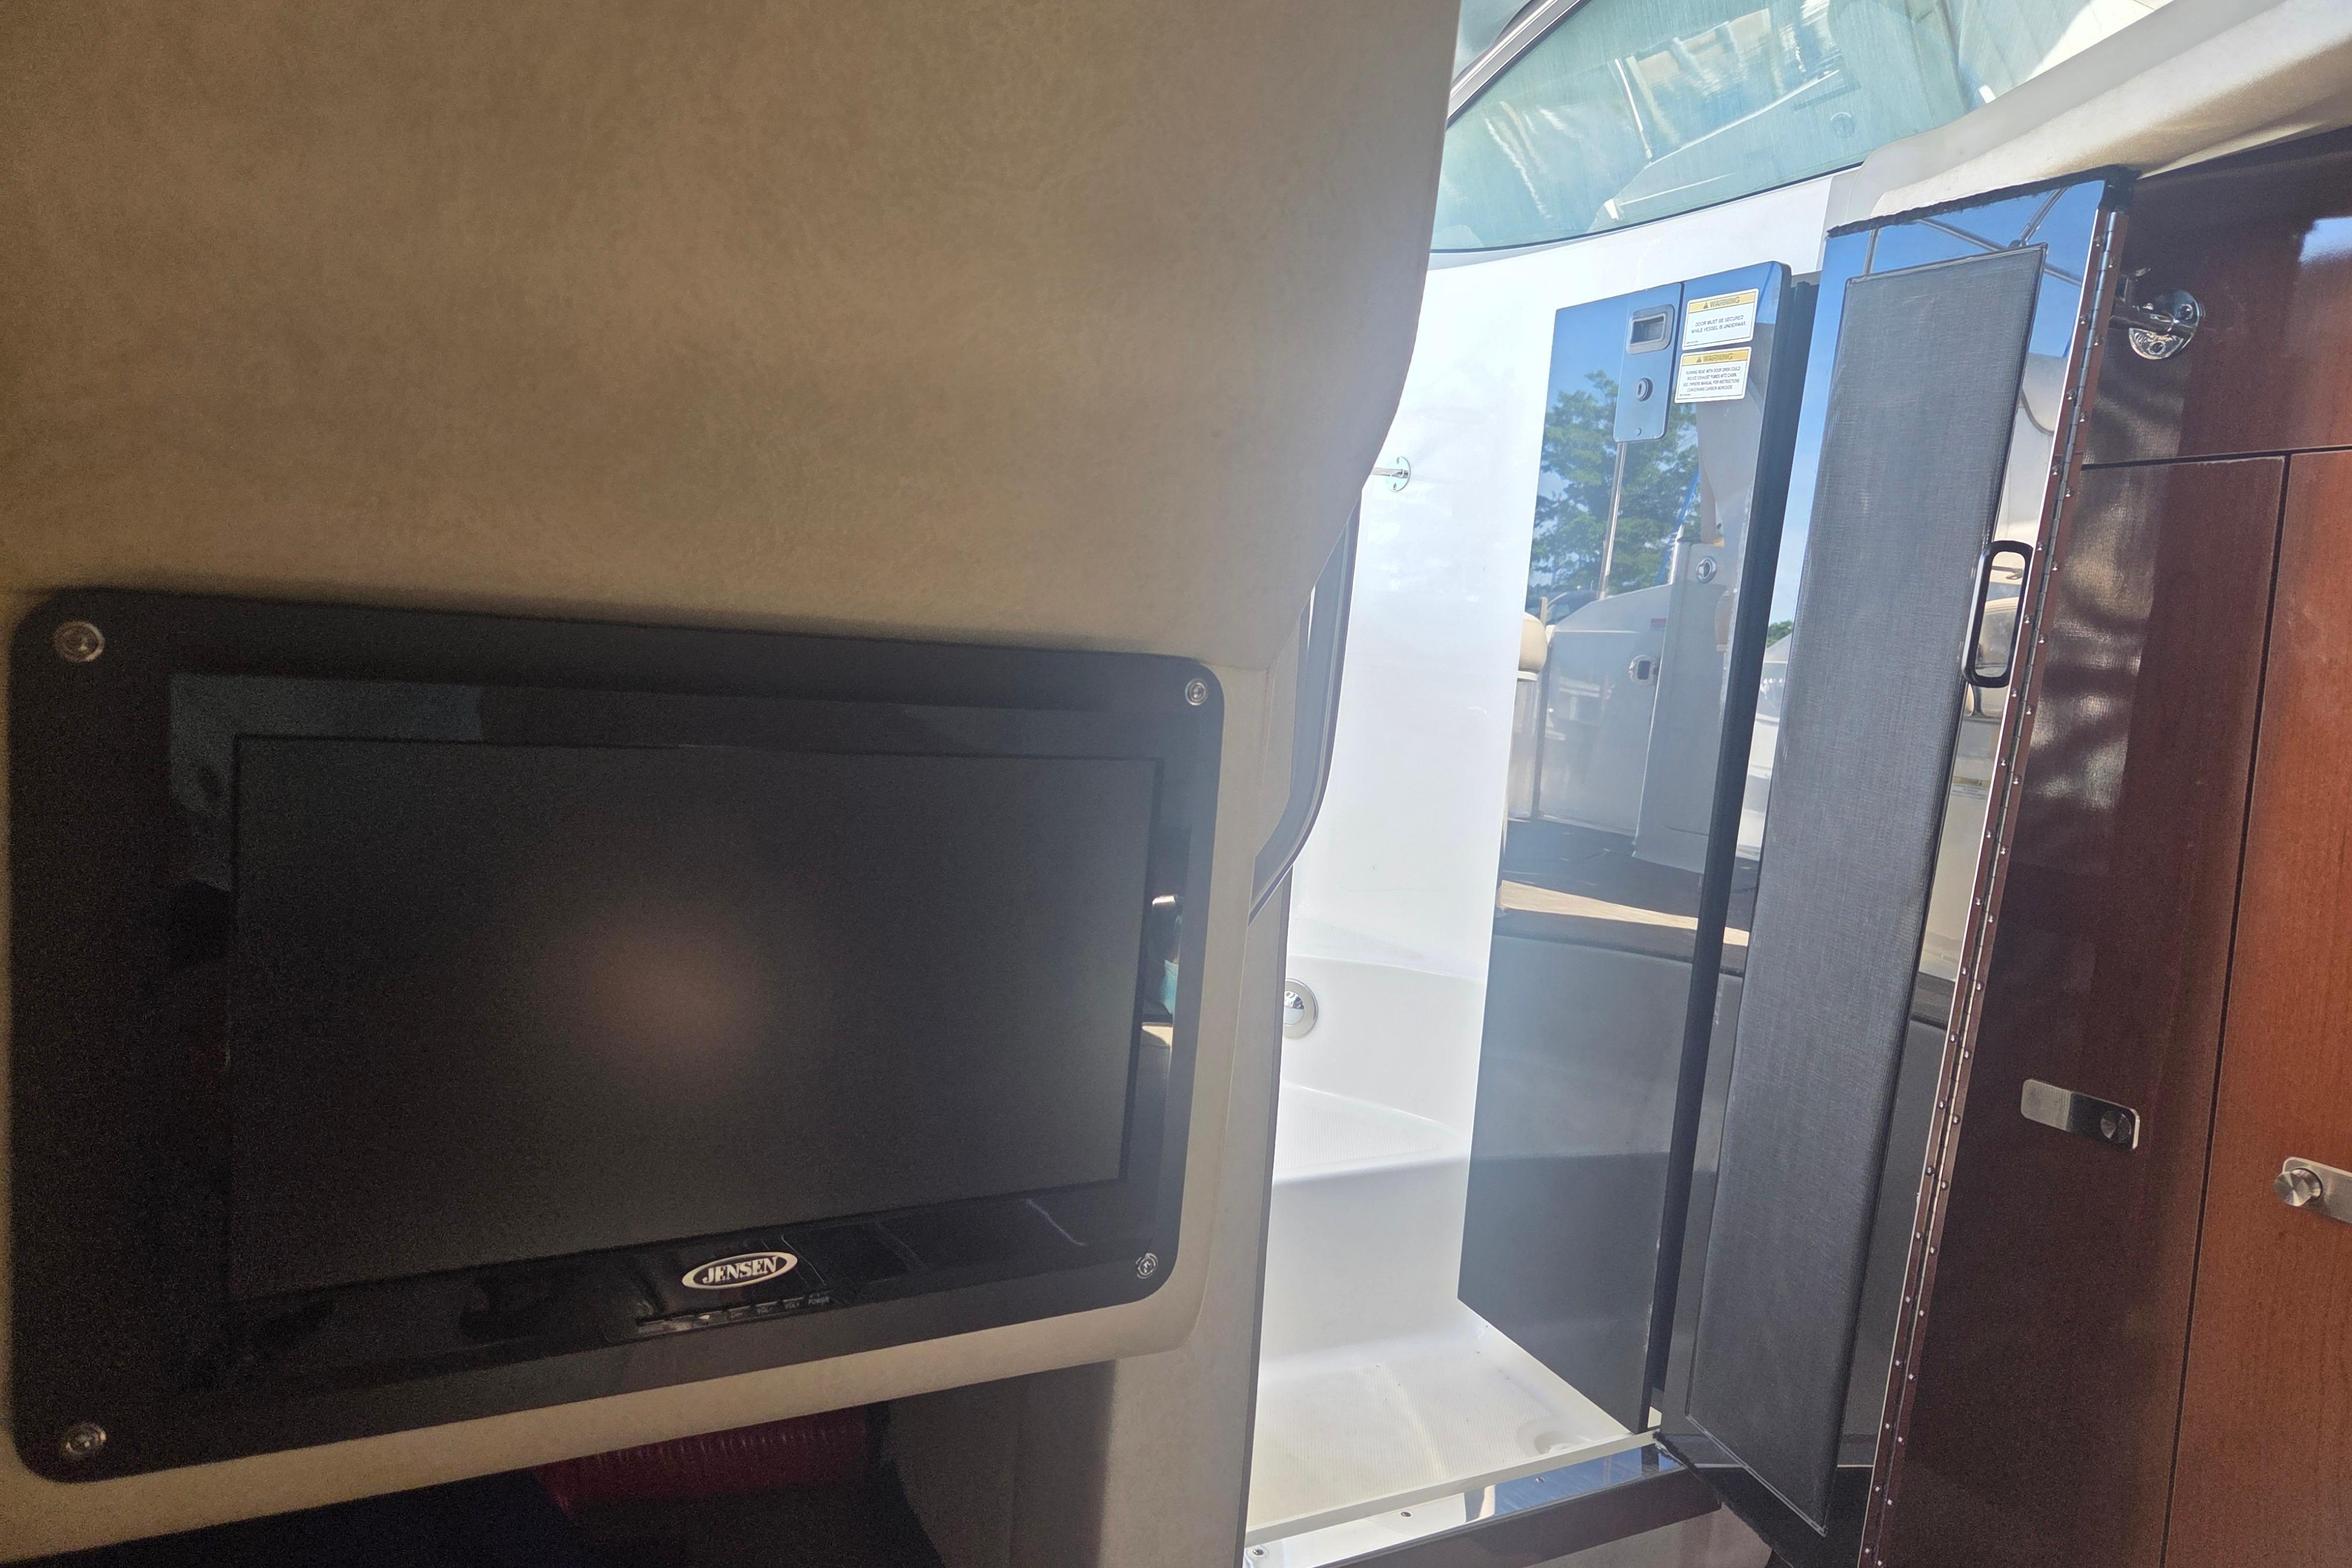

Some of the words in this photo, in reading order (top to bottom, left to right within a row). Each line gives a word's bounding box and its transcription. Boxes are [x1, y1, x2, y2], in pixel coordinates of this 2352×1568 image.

[1710, 297, 1740, 307] WARNING
[1703, 353, 1733, 362] WARNING
[702, 1256, 779, 1283] JENSEN
